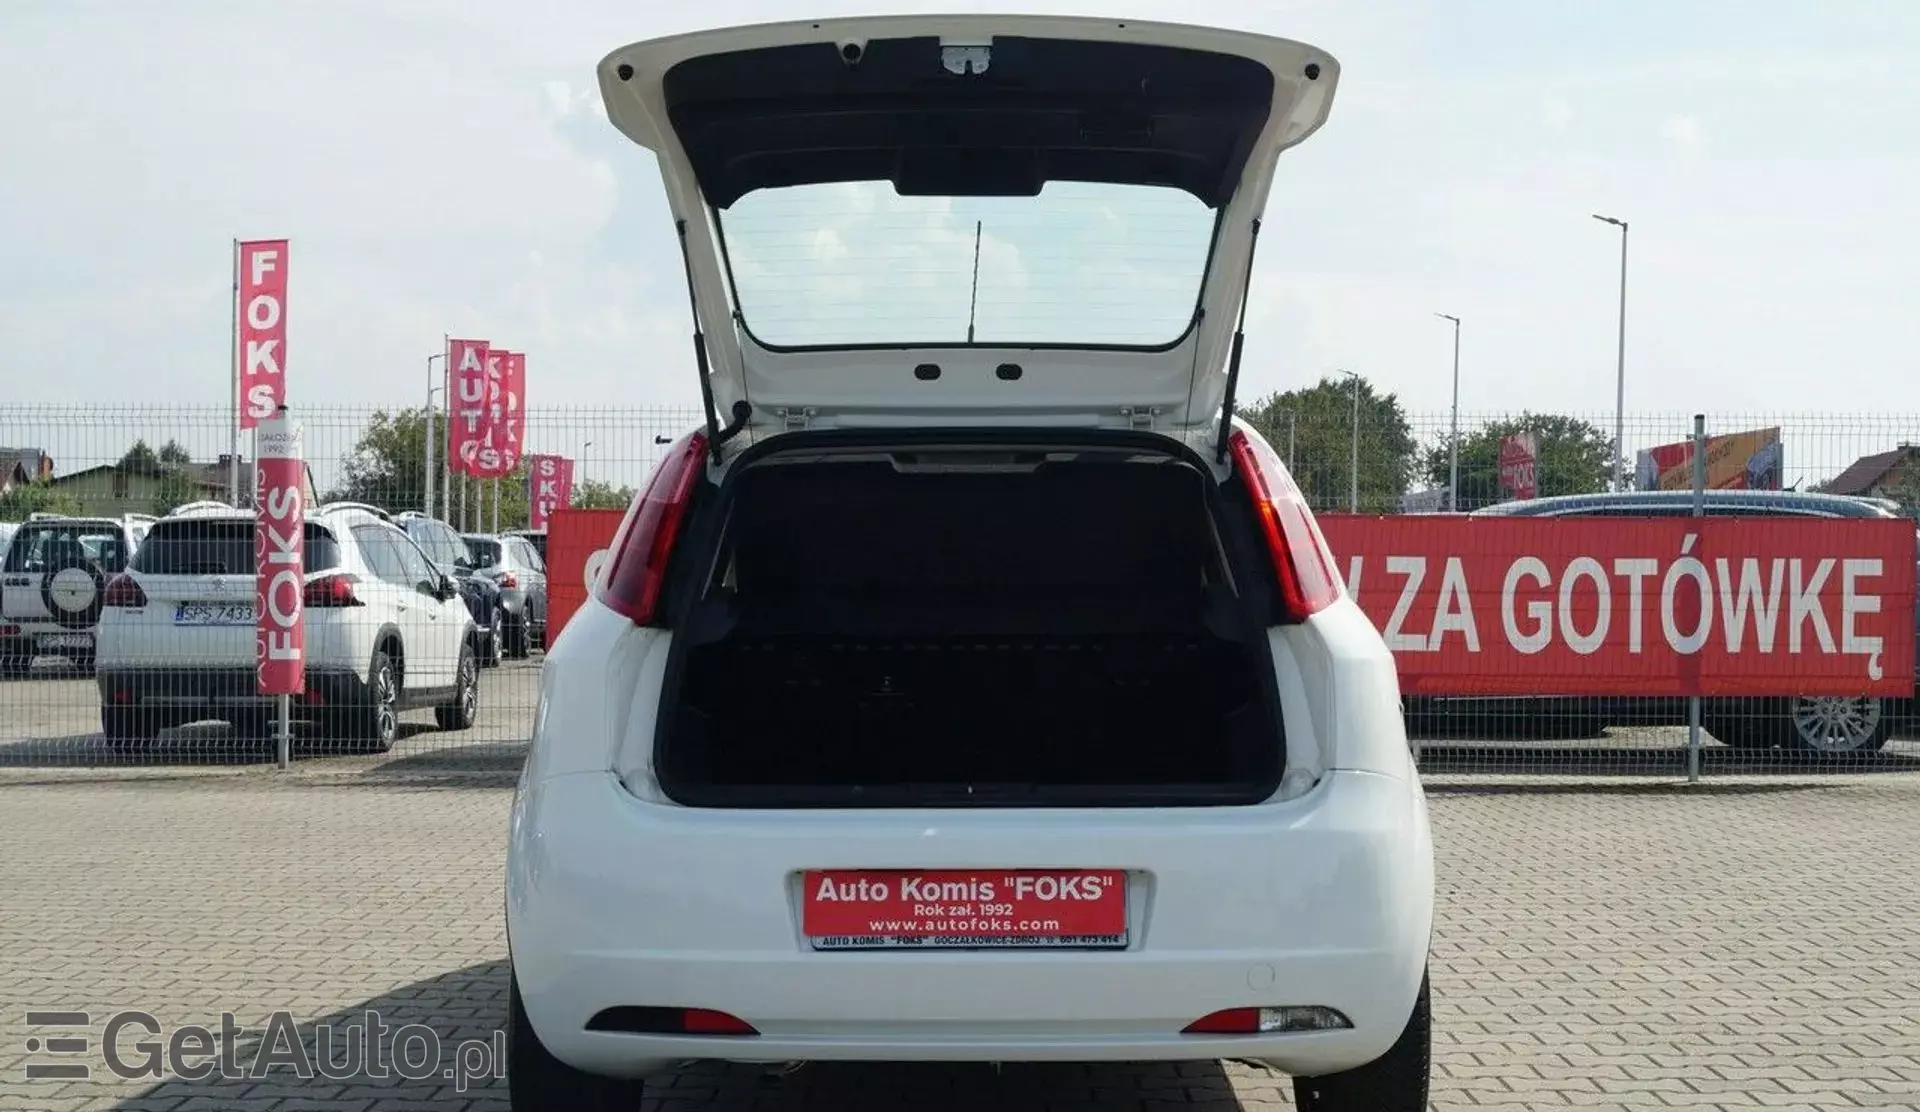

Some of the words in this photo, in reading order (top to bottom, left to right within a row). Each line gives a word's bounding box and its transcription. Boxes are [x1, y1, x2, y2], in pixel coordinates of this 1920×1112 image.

[247, 251, 280, 418] FOKS
[539, 459, 555, 534] SKU
[268, 486, 302, 660] FOKS
[1383, 556, 1480, 652] ZA
[1502, 533, 1884, 680] GOTÓWKĘ
[816, 877, 889, 902] Auto
[901, 877, 995, 902] Komis
[1004, 876, 1113, 901] "FOKS"
[914, 903, 944, 916] Rok
[949, 903, 976, 916] zał.
[980, 903, 1013, 916] 1992
[823, 936, 849, 945] AUTO
[852, 936, 885, 945] KOMIS
[869, 918, 1060, 932] www.autofoks.com
